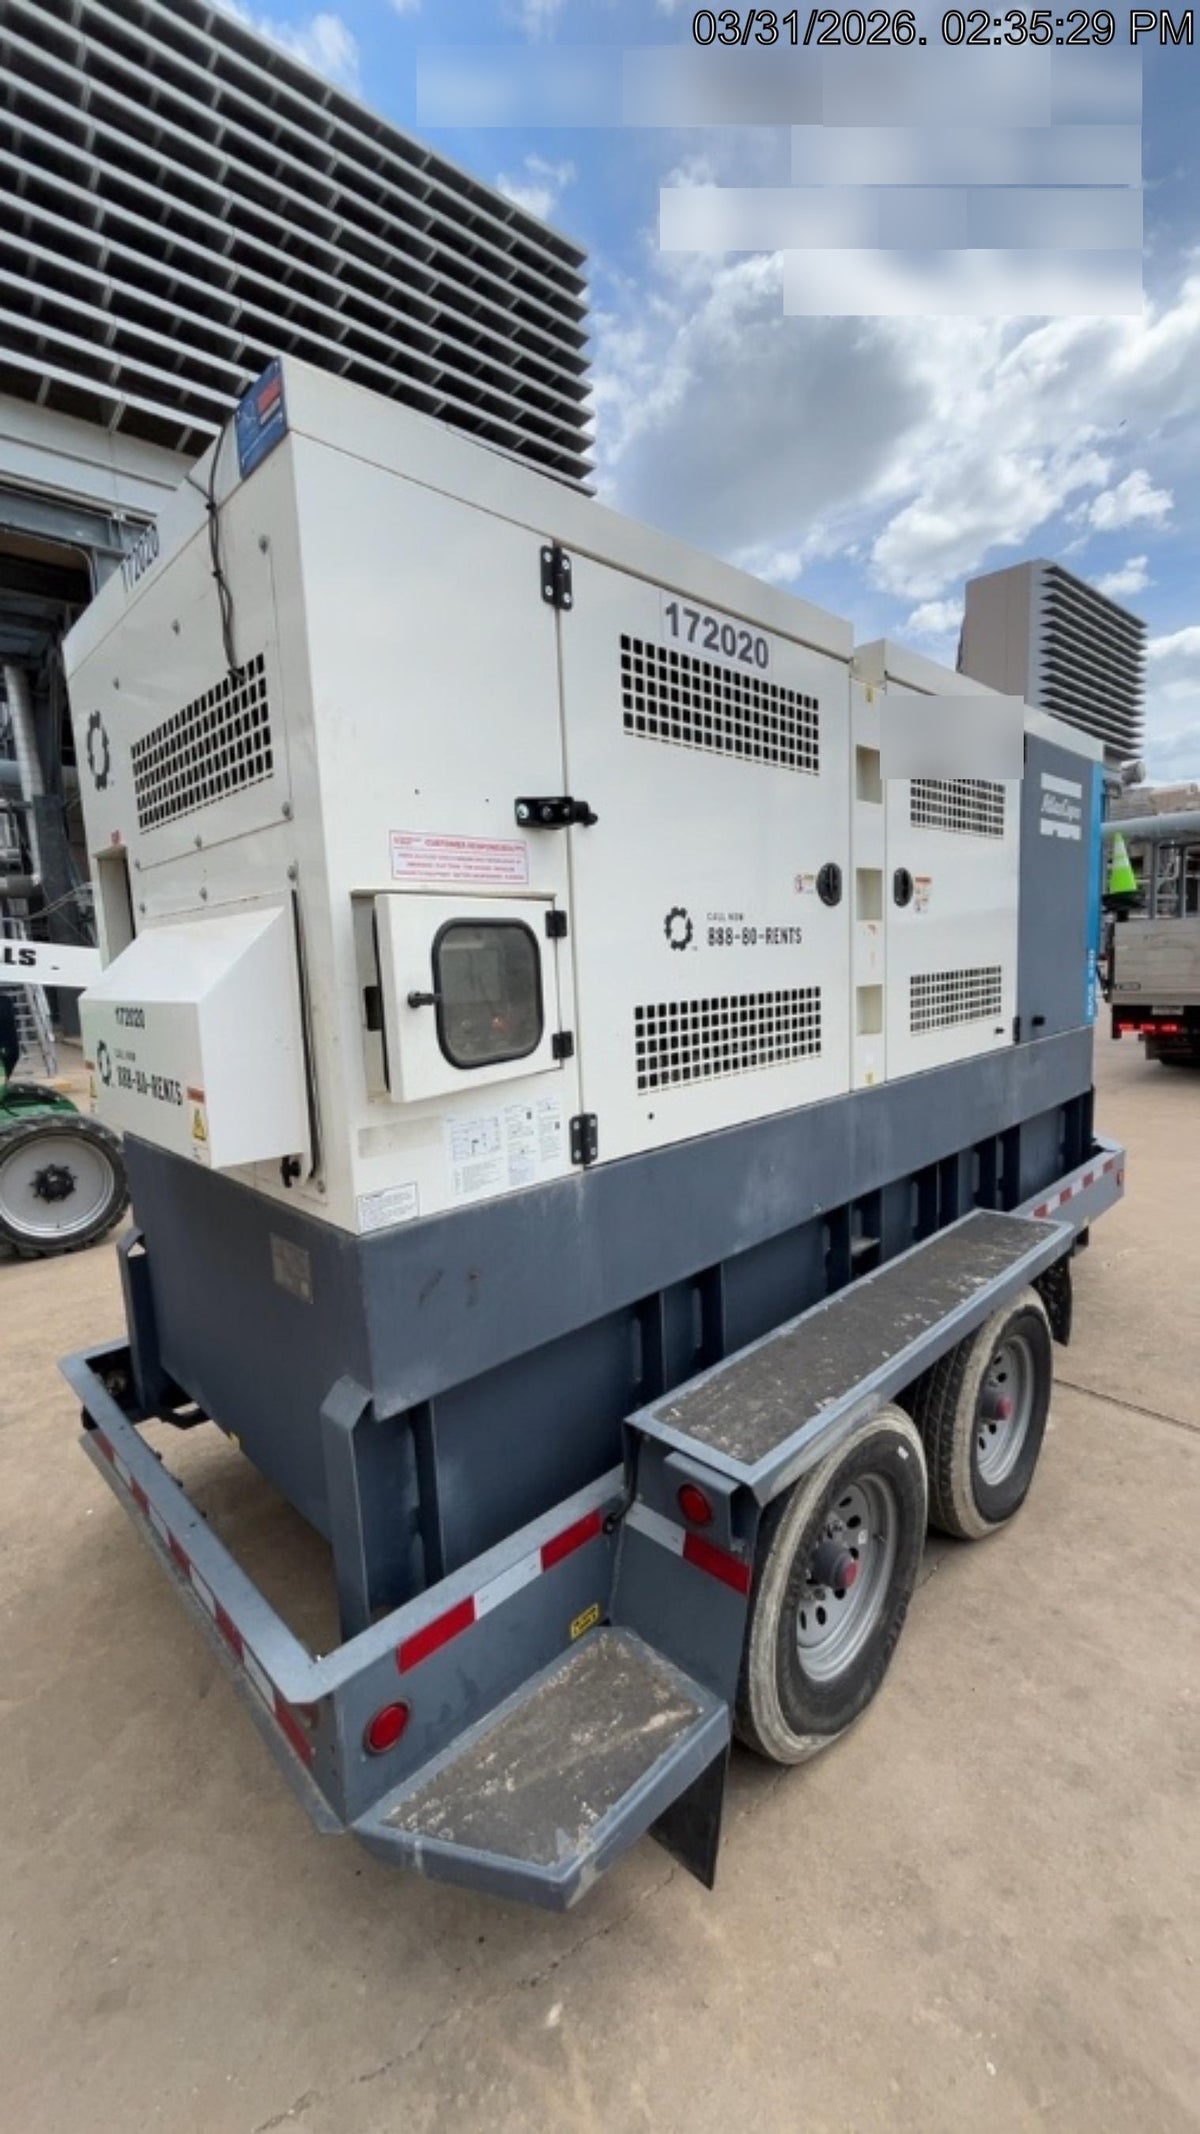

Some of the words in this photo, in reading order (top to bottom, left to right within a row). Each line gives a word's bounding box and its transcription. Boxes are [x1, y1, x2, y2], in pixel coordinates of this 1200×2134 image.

[665, 602, 769, 669] 172020
[707, 926, 803, 947] 888-80-RENTS
[0, 947, 37, 967] LS
[115, 1007, 146, 1029] 172020
[117, 1066, 184, 1106] 888-80-RENTS
